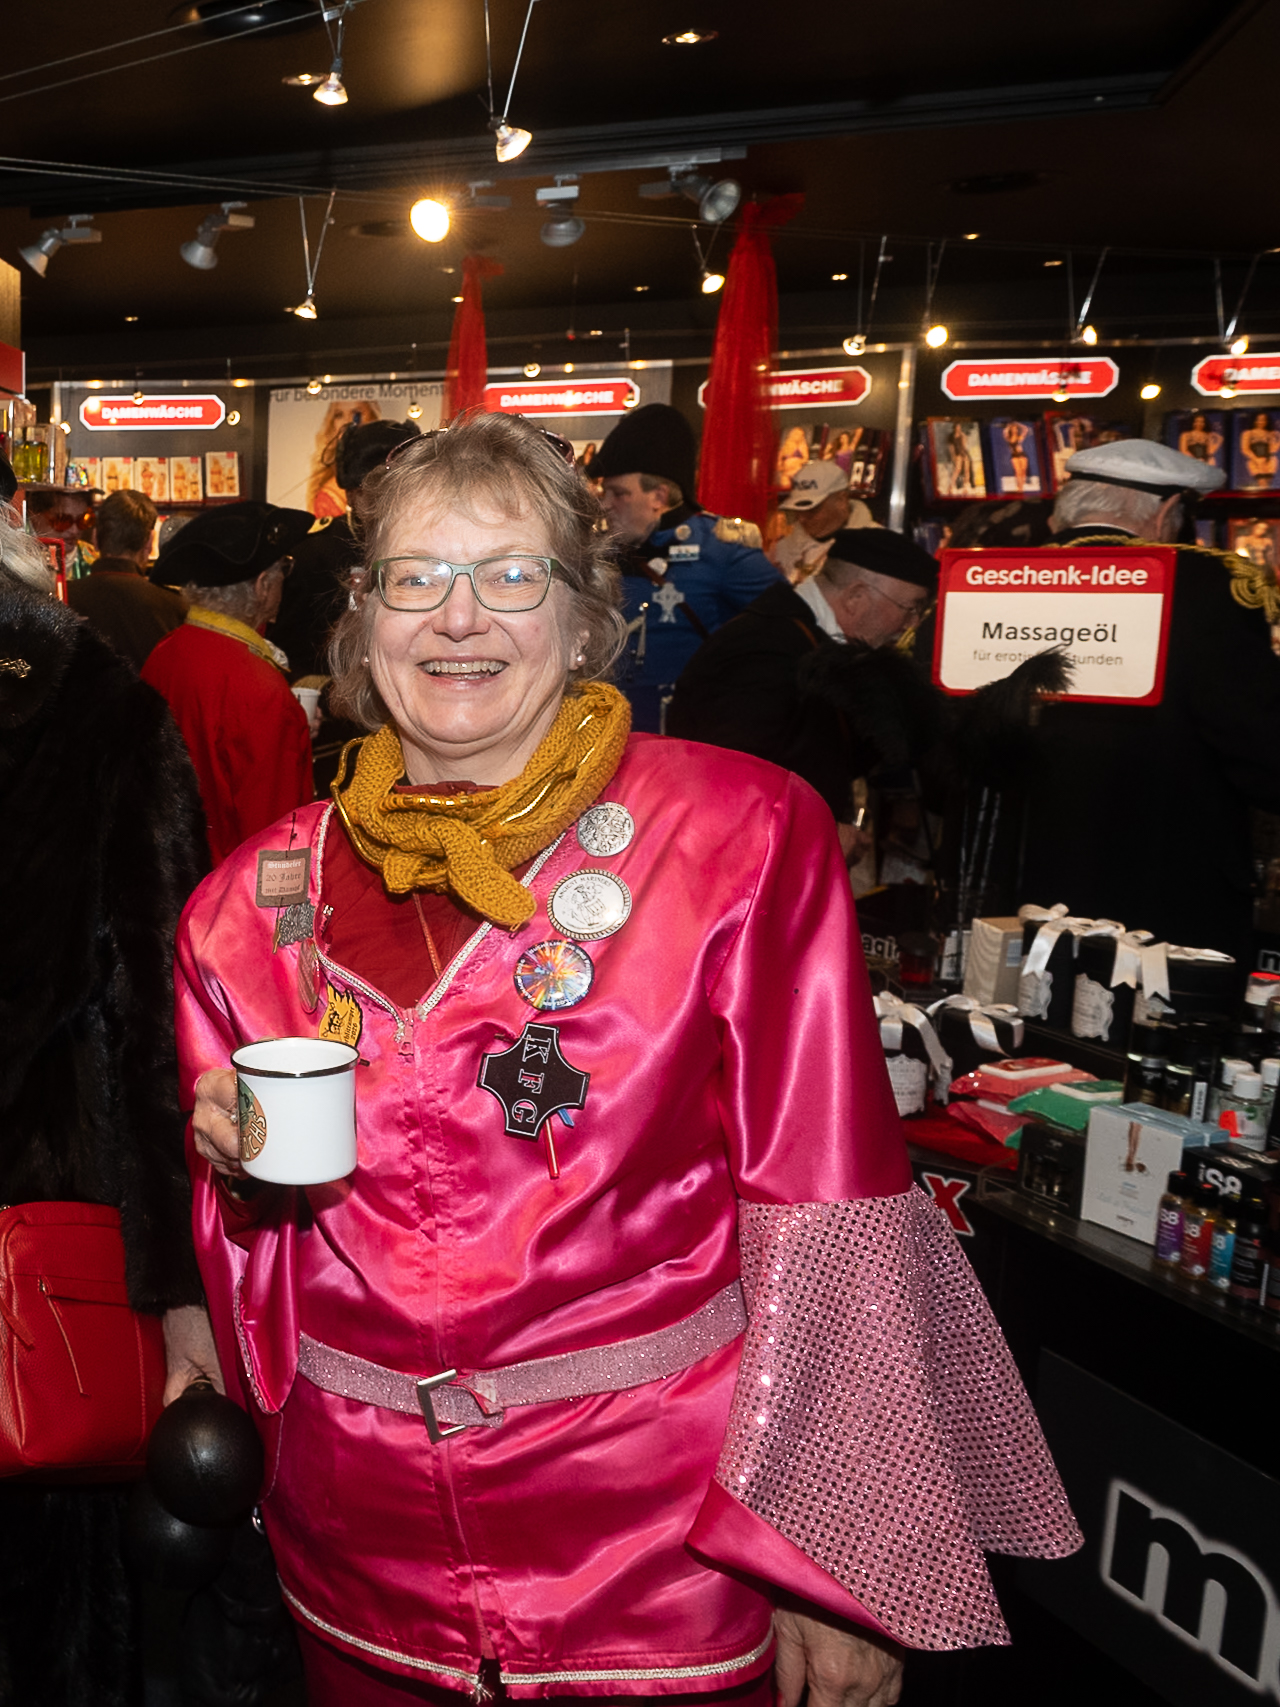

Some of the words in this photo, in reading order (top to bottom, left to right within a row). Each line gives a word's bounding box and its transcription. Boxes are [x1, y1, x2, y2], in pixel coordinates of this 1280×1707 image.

[294, 386, 375, 402] beondere
[102, 404, 203, 419] DAMENWÄSCHE
[966, 564, 1148, 586] Geschenk-Idee
[982, 622, 1118, 646] Massageöl
[973, 650, 991, 662] für
[266, 873, 277, 882] 20
[558, 879, 578, 899] ANCIENT
[580, 876, 613, 887] MARINERS
